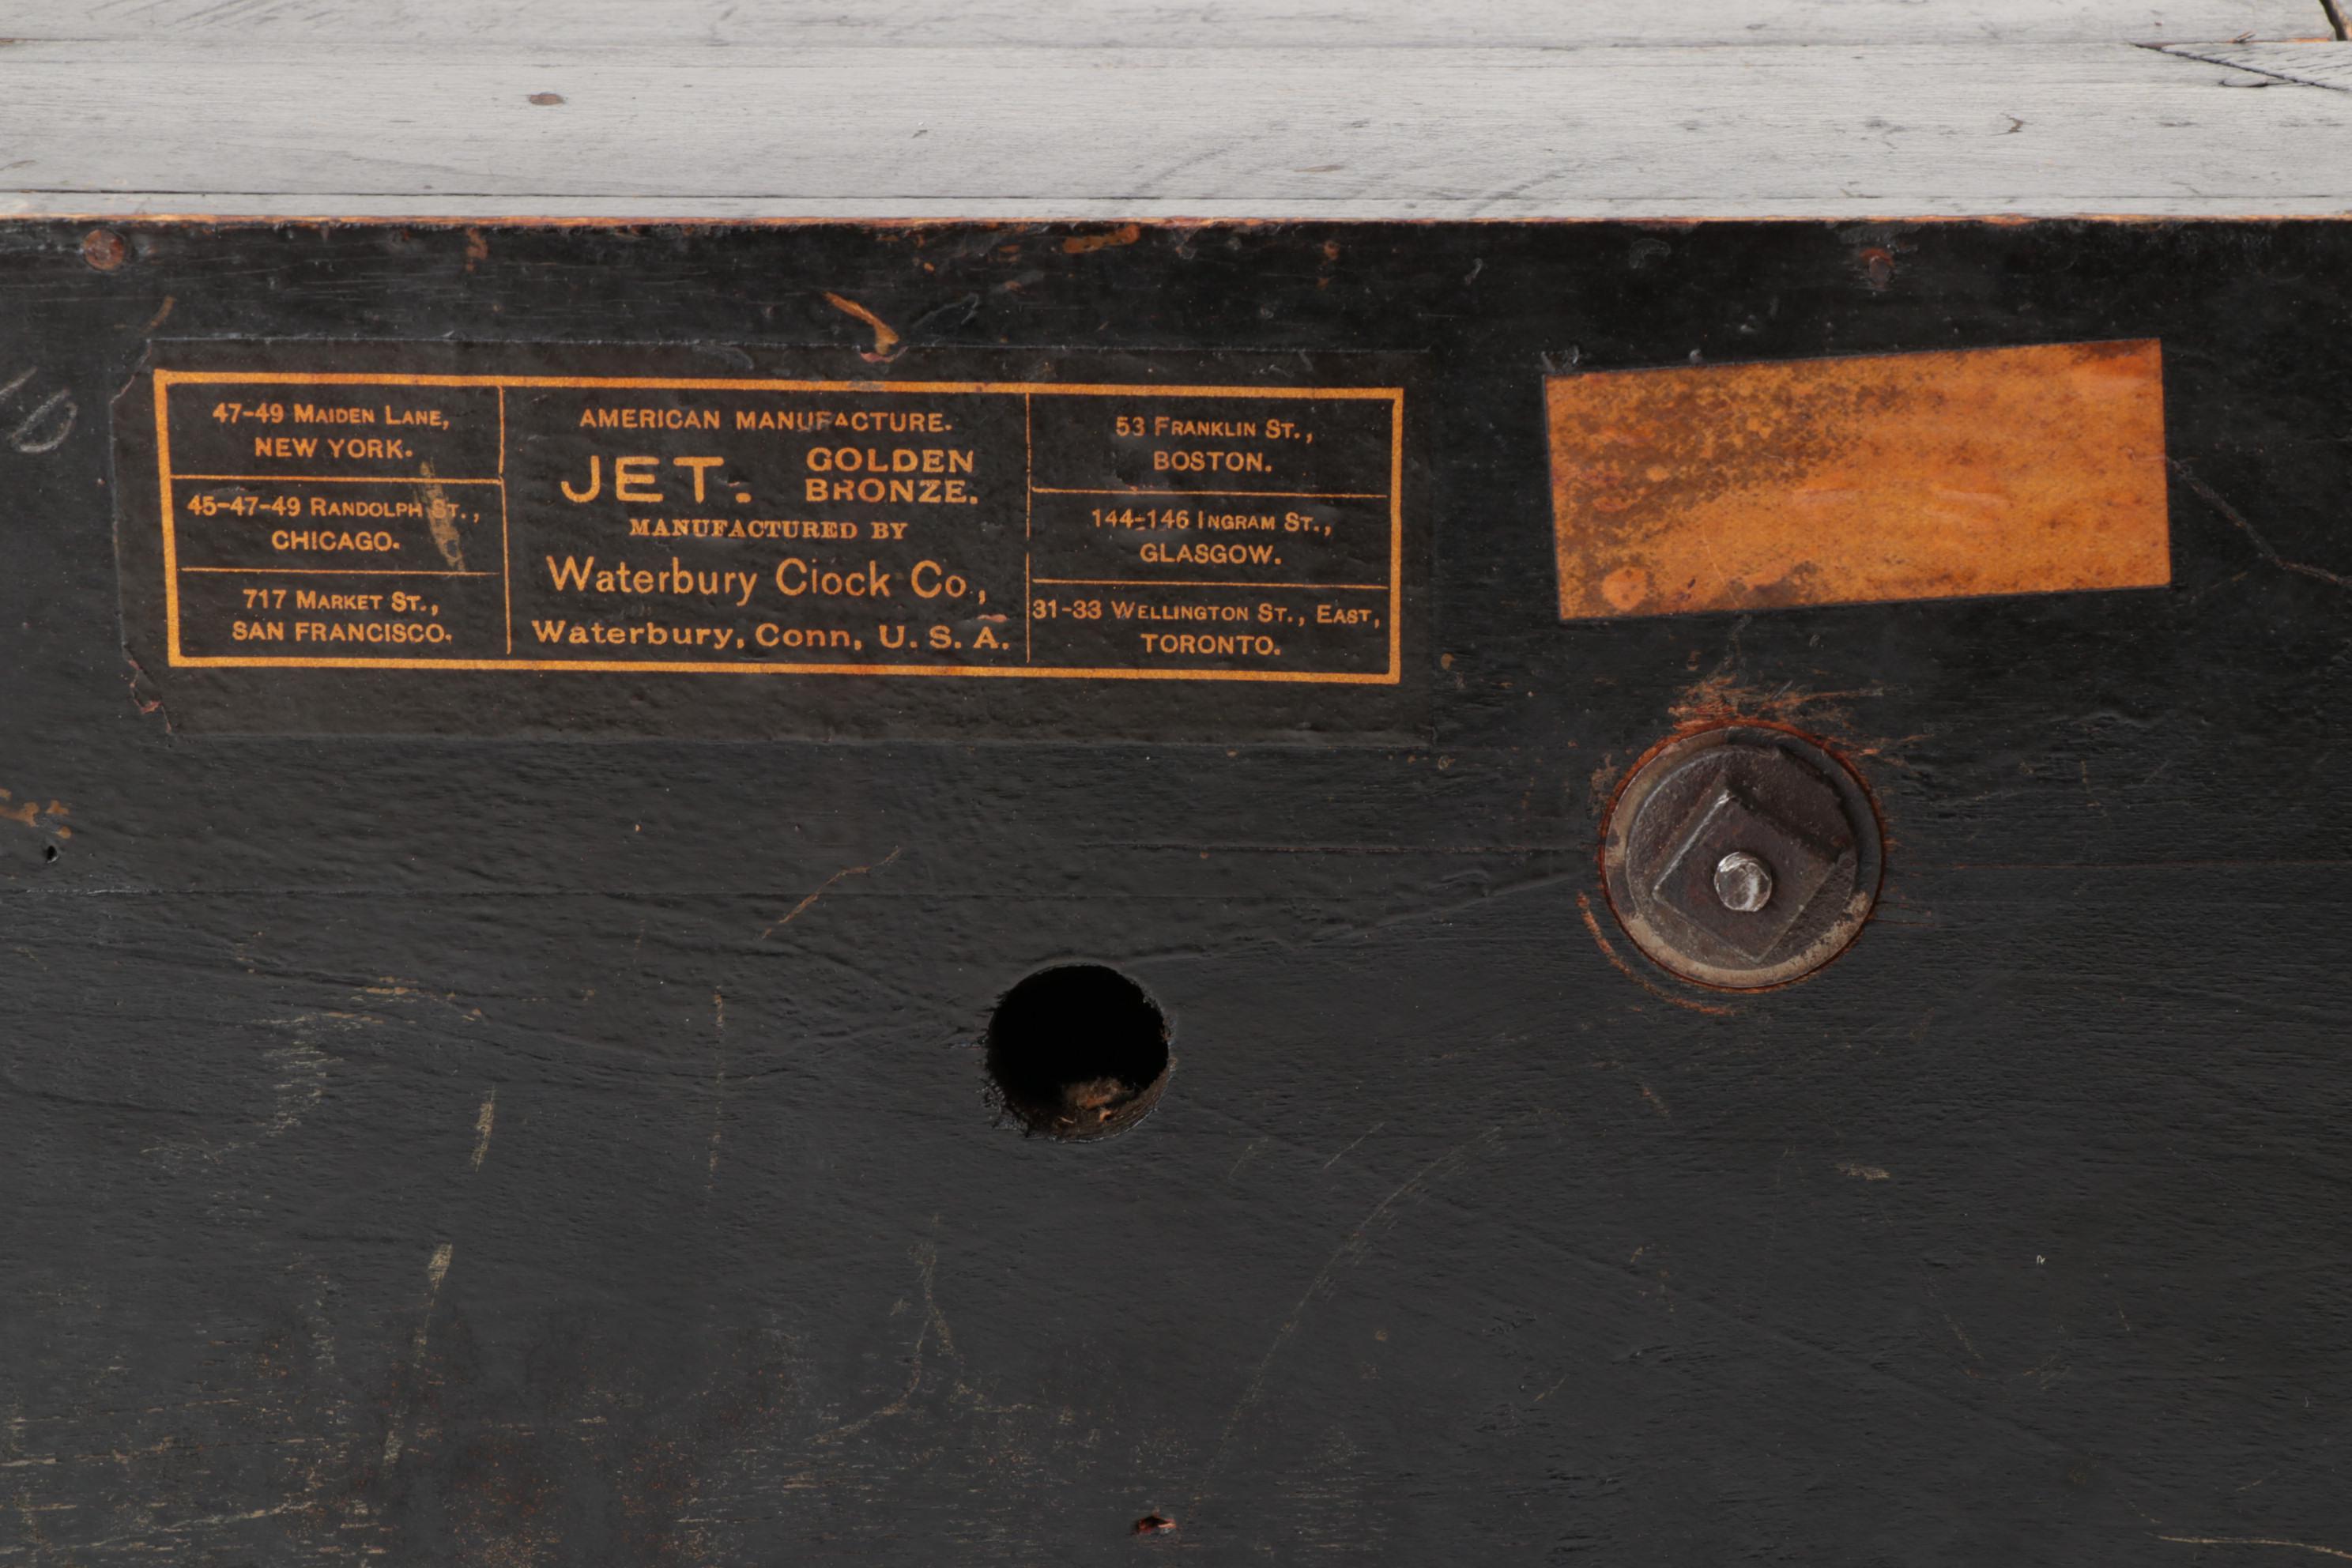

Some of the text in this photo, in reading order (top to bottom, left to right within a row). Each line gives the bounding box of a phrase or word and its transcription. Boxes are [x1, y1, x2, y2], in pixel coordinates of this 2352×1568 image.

[212, 401, 450, 431] 47-49 MAIDEN LANE,
[580, 408, 952, 433] AMERICAN MANUFACTURE.
[1115, 416, 1313, 443] 53 FRANKLIN ST.,
[254, 436, 413, 460] NEW YORK.
[806, 447, 974, 473] GOLDEN
[1153, 450, 1272, 473] BOSTON.
[560, 454, 752, 504] JET.
[805, 477, 978, 505] BRONZE.
[187, 493, 302, 518] 45-47-49
[310, 496, 424, 518] RANDOLPH
[628, 518, 909, 540] MANUFACTURED BY
[1091, 508, 1332, 537] 144-146 INGRAM ST.,
[271, 530, 401, 552] CHICAGO.
[1140, 542, 1282, 565] GLASGOW.
[545, 555, 758, 607] Waterbury
[242, 588, 439, 616] 717 MARKET ST.,
[1031, 598, 1380, 628] 31-33 WELLINGTON ST., EAST,
[232, 620, 453, 644] SAN FRANCISCO.
[531, 619, 1010, 651] Waterbury, Conn, U. S. A.
[1140, 633, 1281, 656] TORONTO.
